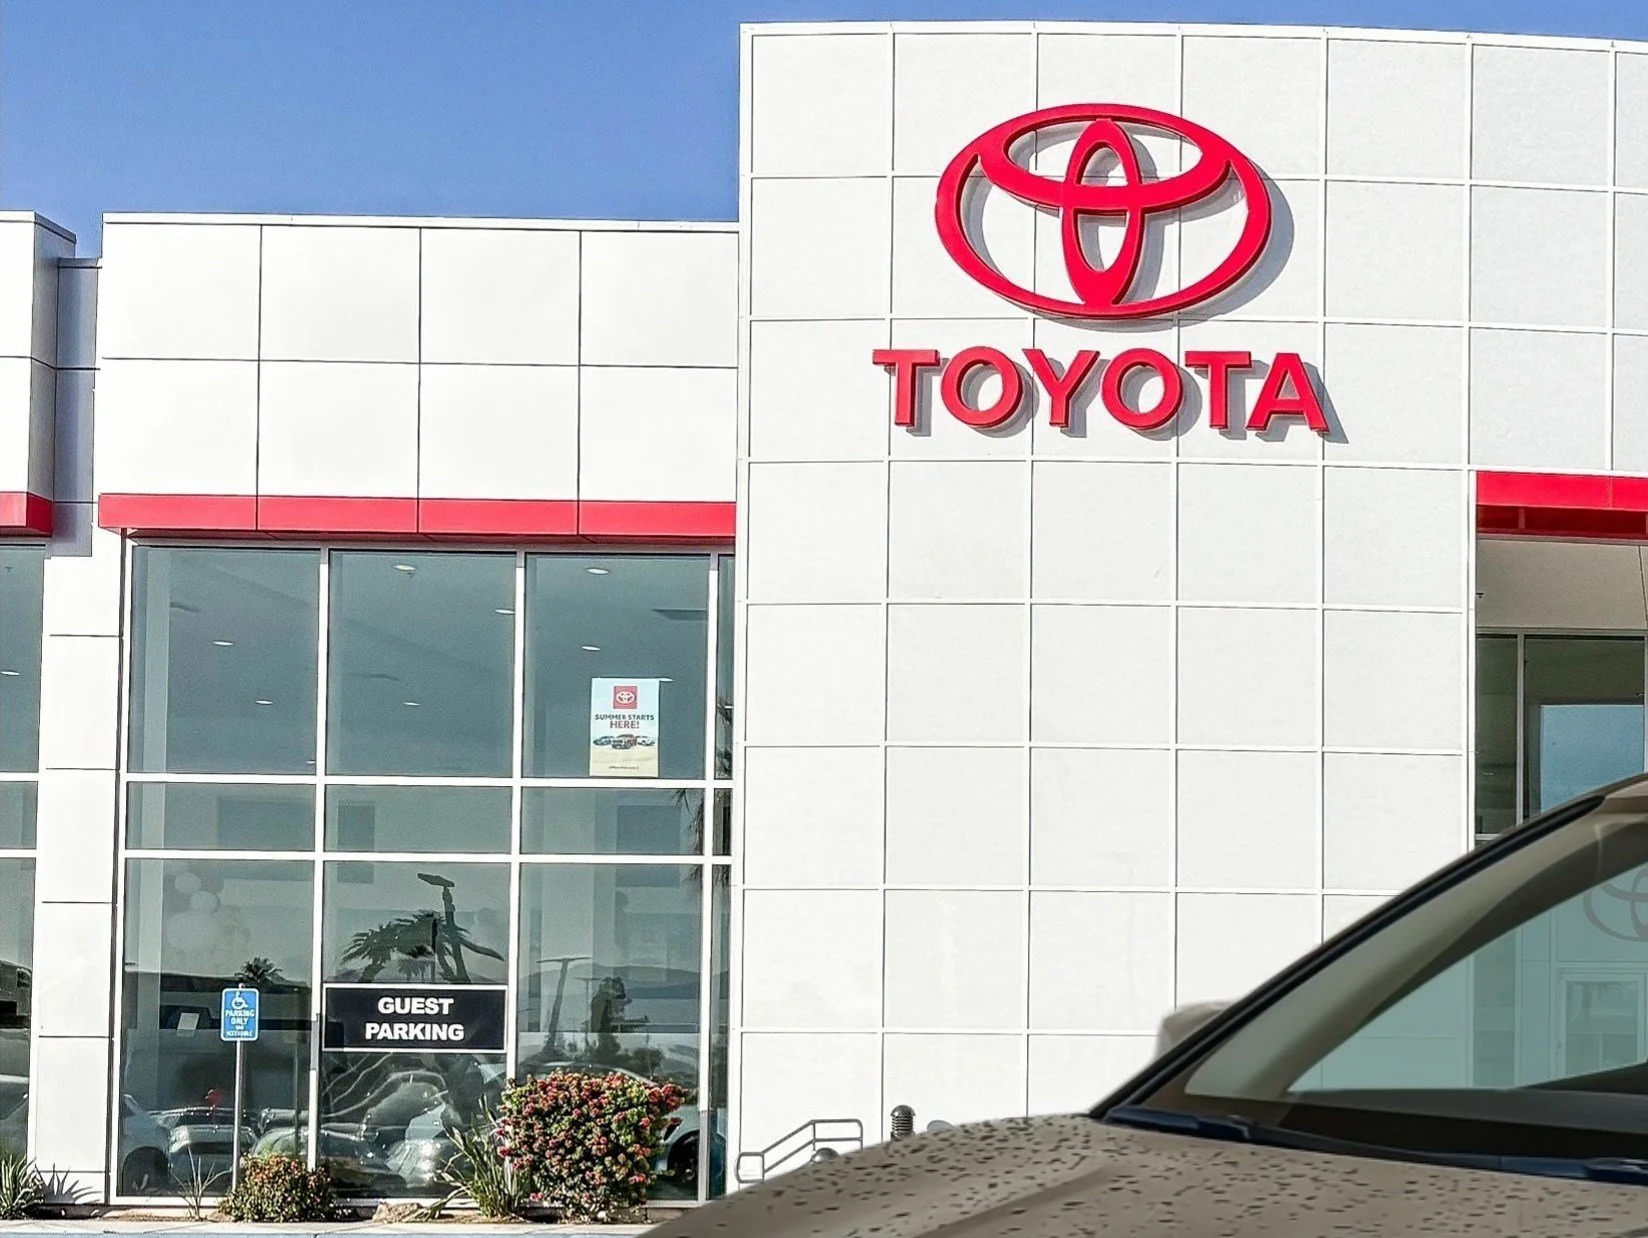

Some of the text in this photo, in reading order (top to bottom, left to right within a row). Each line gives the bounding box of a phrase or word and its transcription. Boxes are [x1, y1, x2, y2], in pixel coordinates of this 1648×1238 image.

[872, 345, 1332, 434] TOYOTA
[610, 721, 640, 729] HERE!
[377, 997, 454, 1015] GUEST
[225, 1009, 255, 1017] PARKING
[230, 1017, 248, 1025] ONLY
[365, 1023, 465, 1041] PARKING
